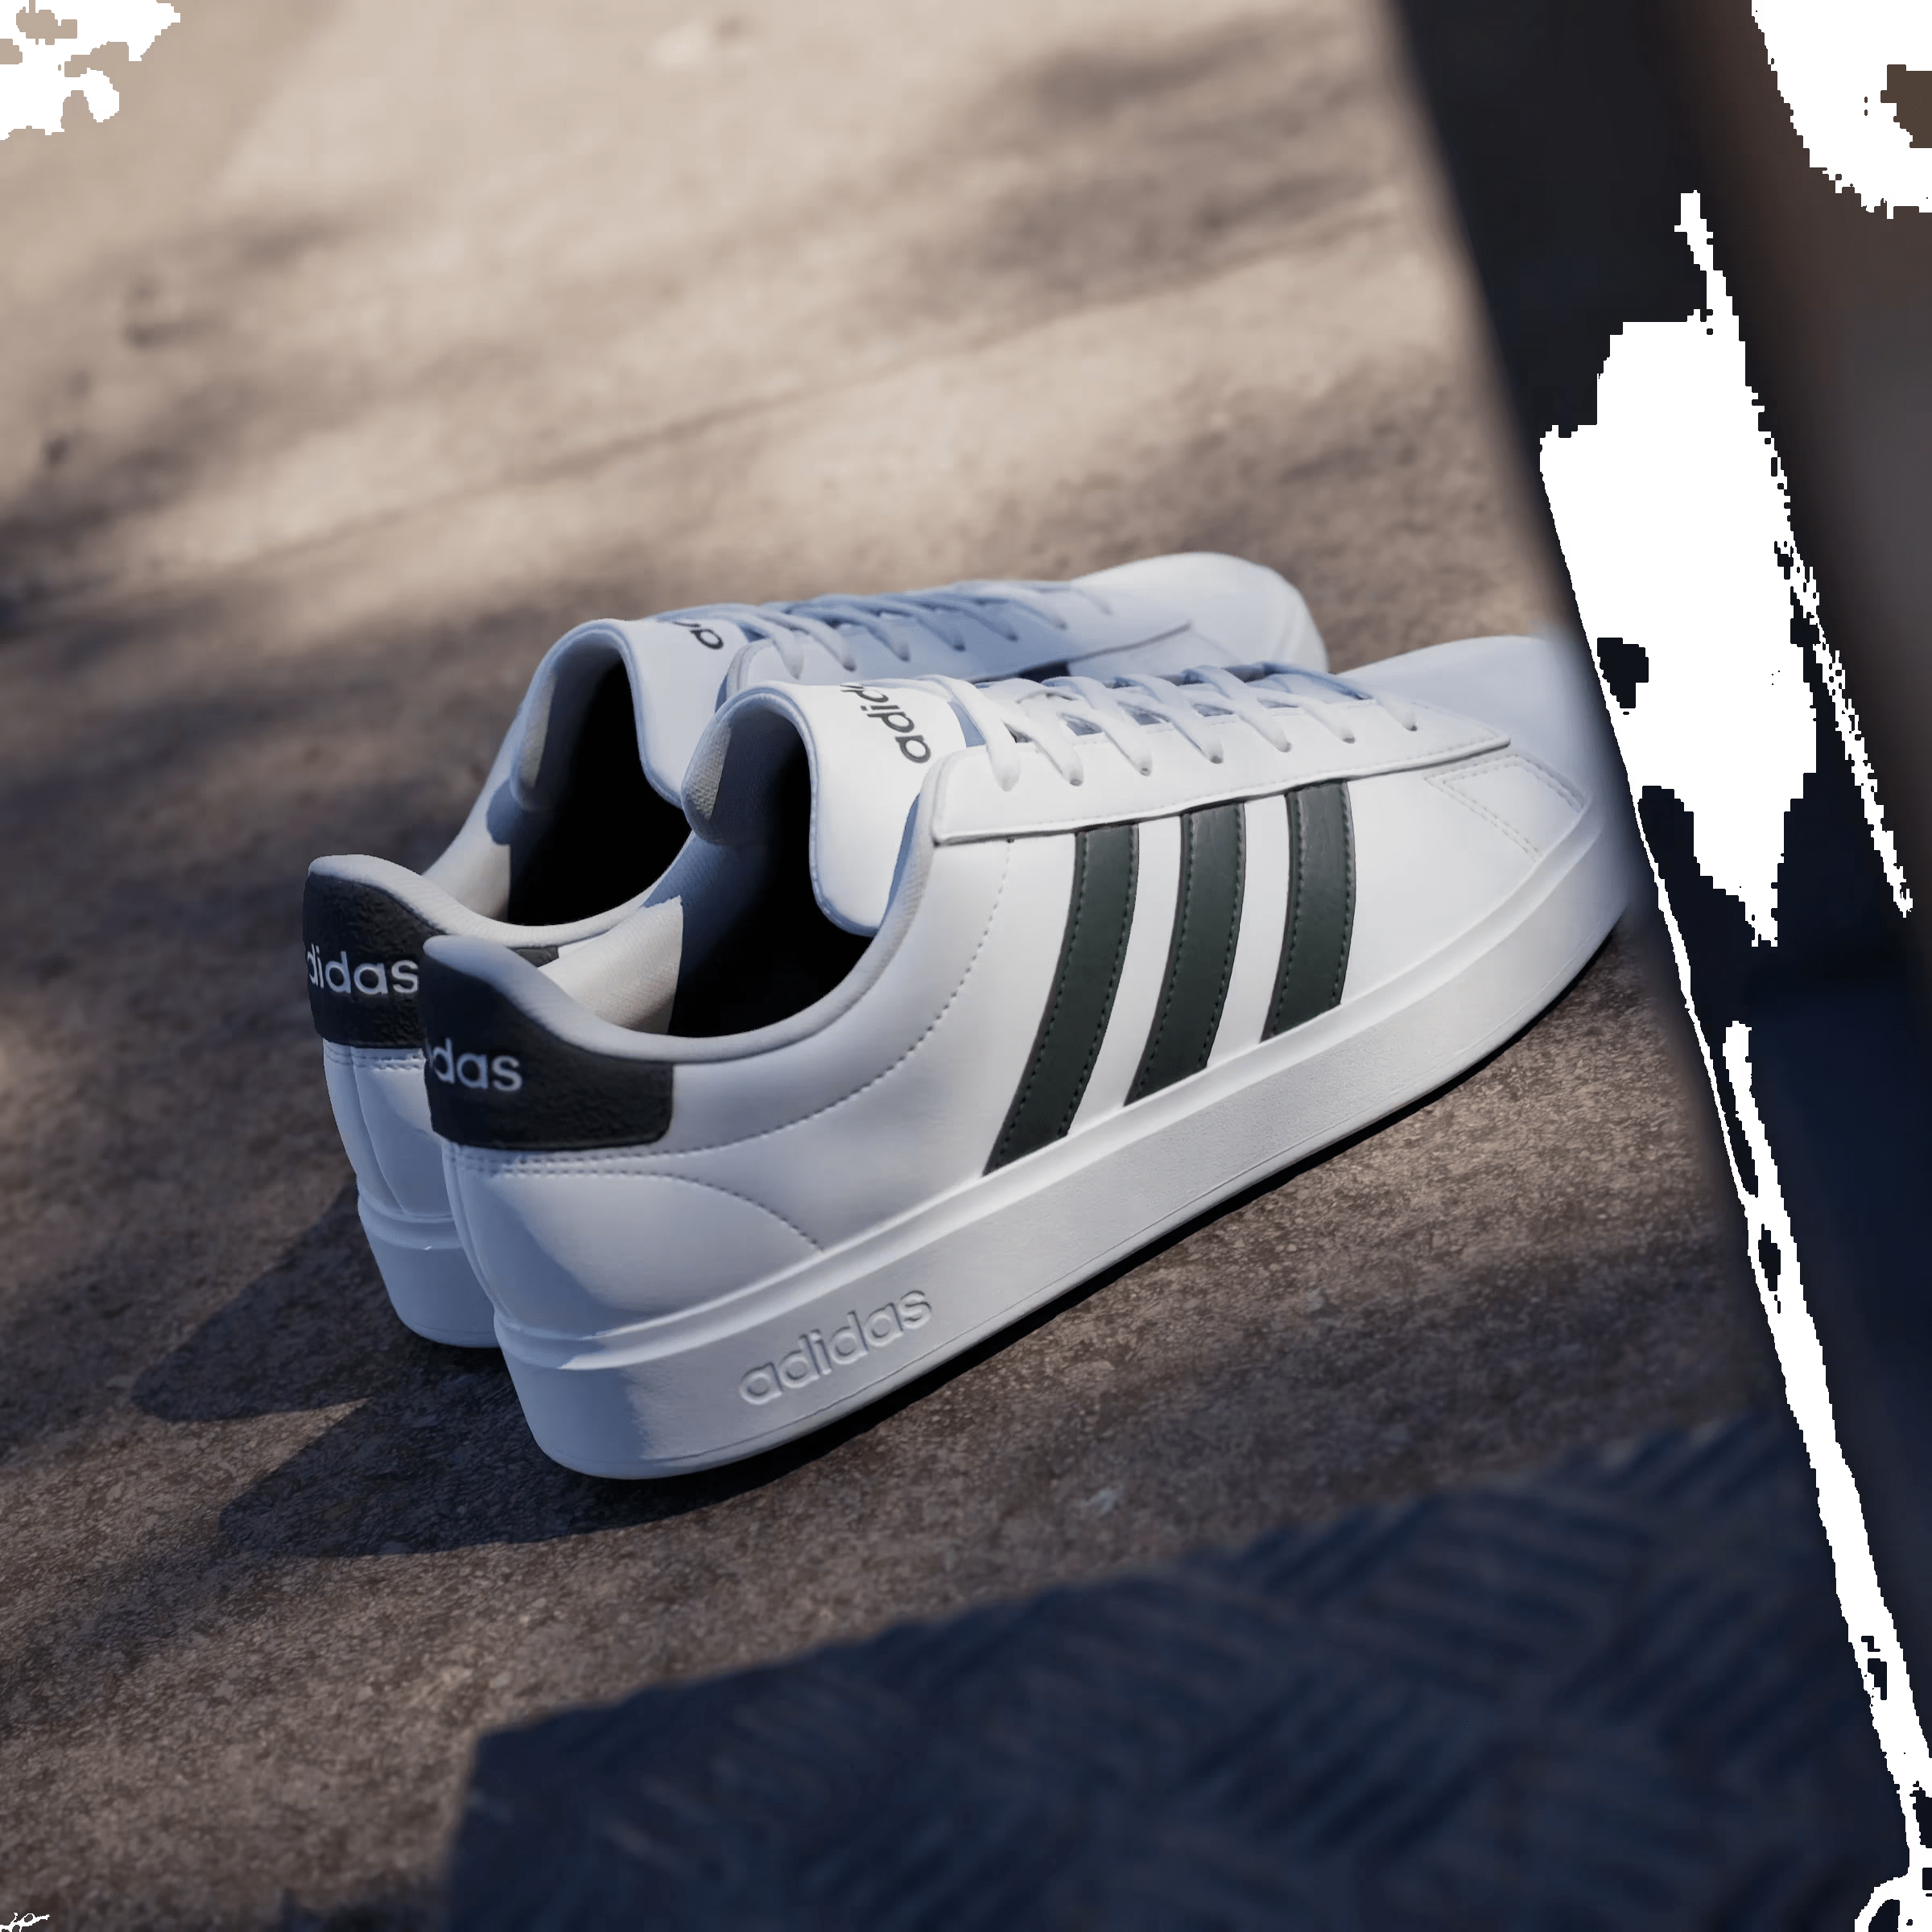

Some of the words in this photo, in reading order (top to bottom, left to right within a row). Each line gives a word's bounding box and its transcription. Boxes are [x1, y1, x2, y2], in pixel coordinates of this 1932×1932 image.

[840, 684, 931, 764] adid
[307, 943, 419, 995] didas
[431, 1037, 522, 1092] das
[739, 1290, 932, 1406] adidas
